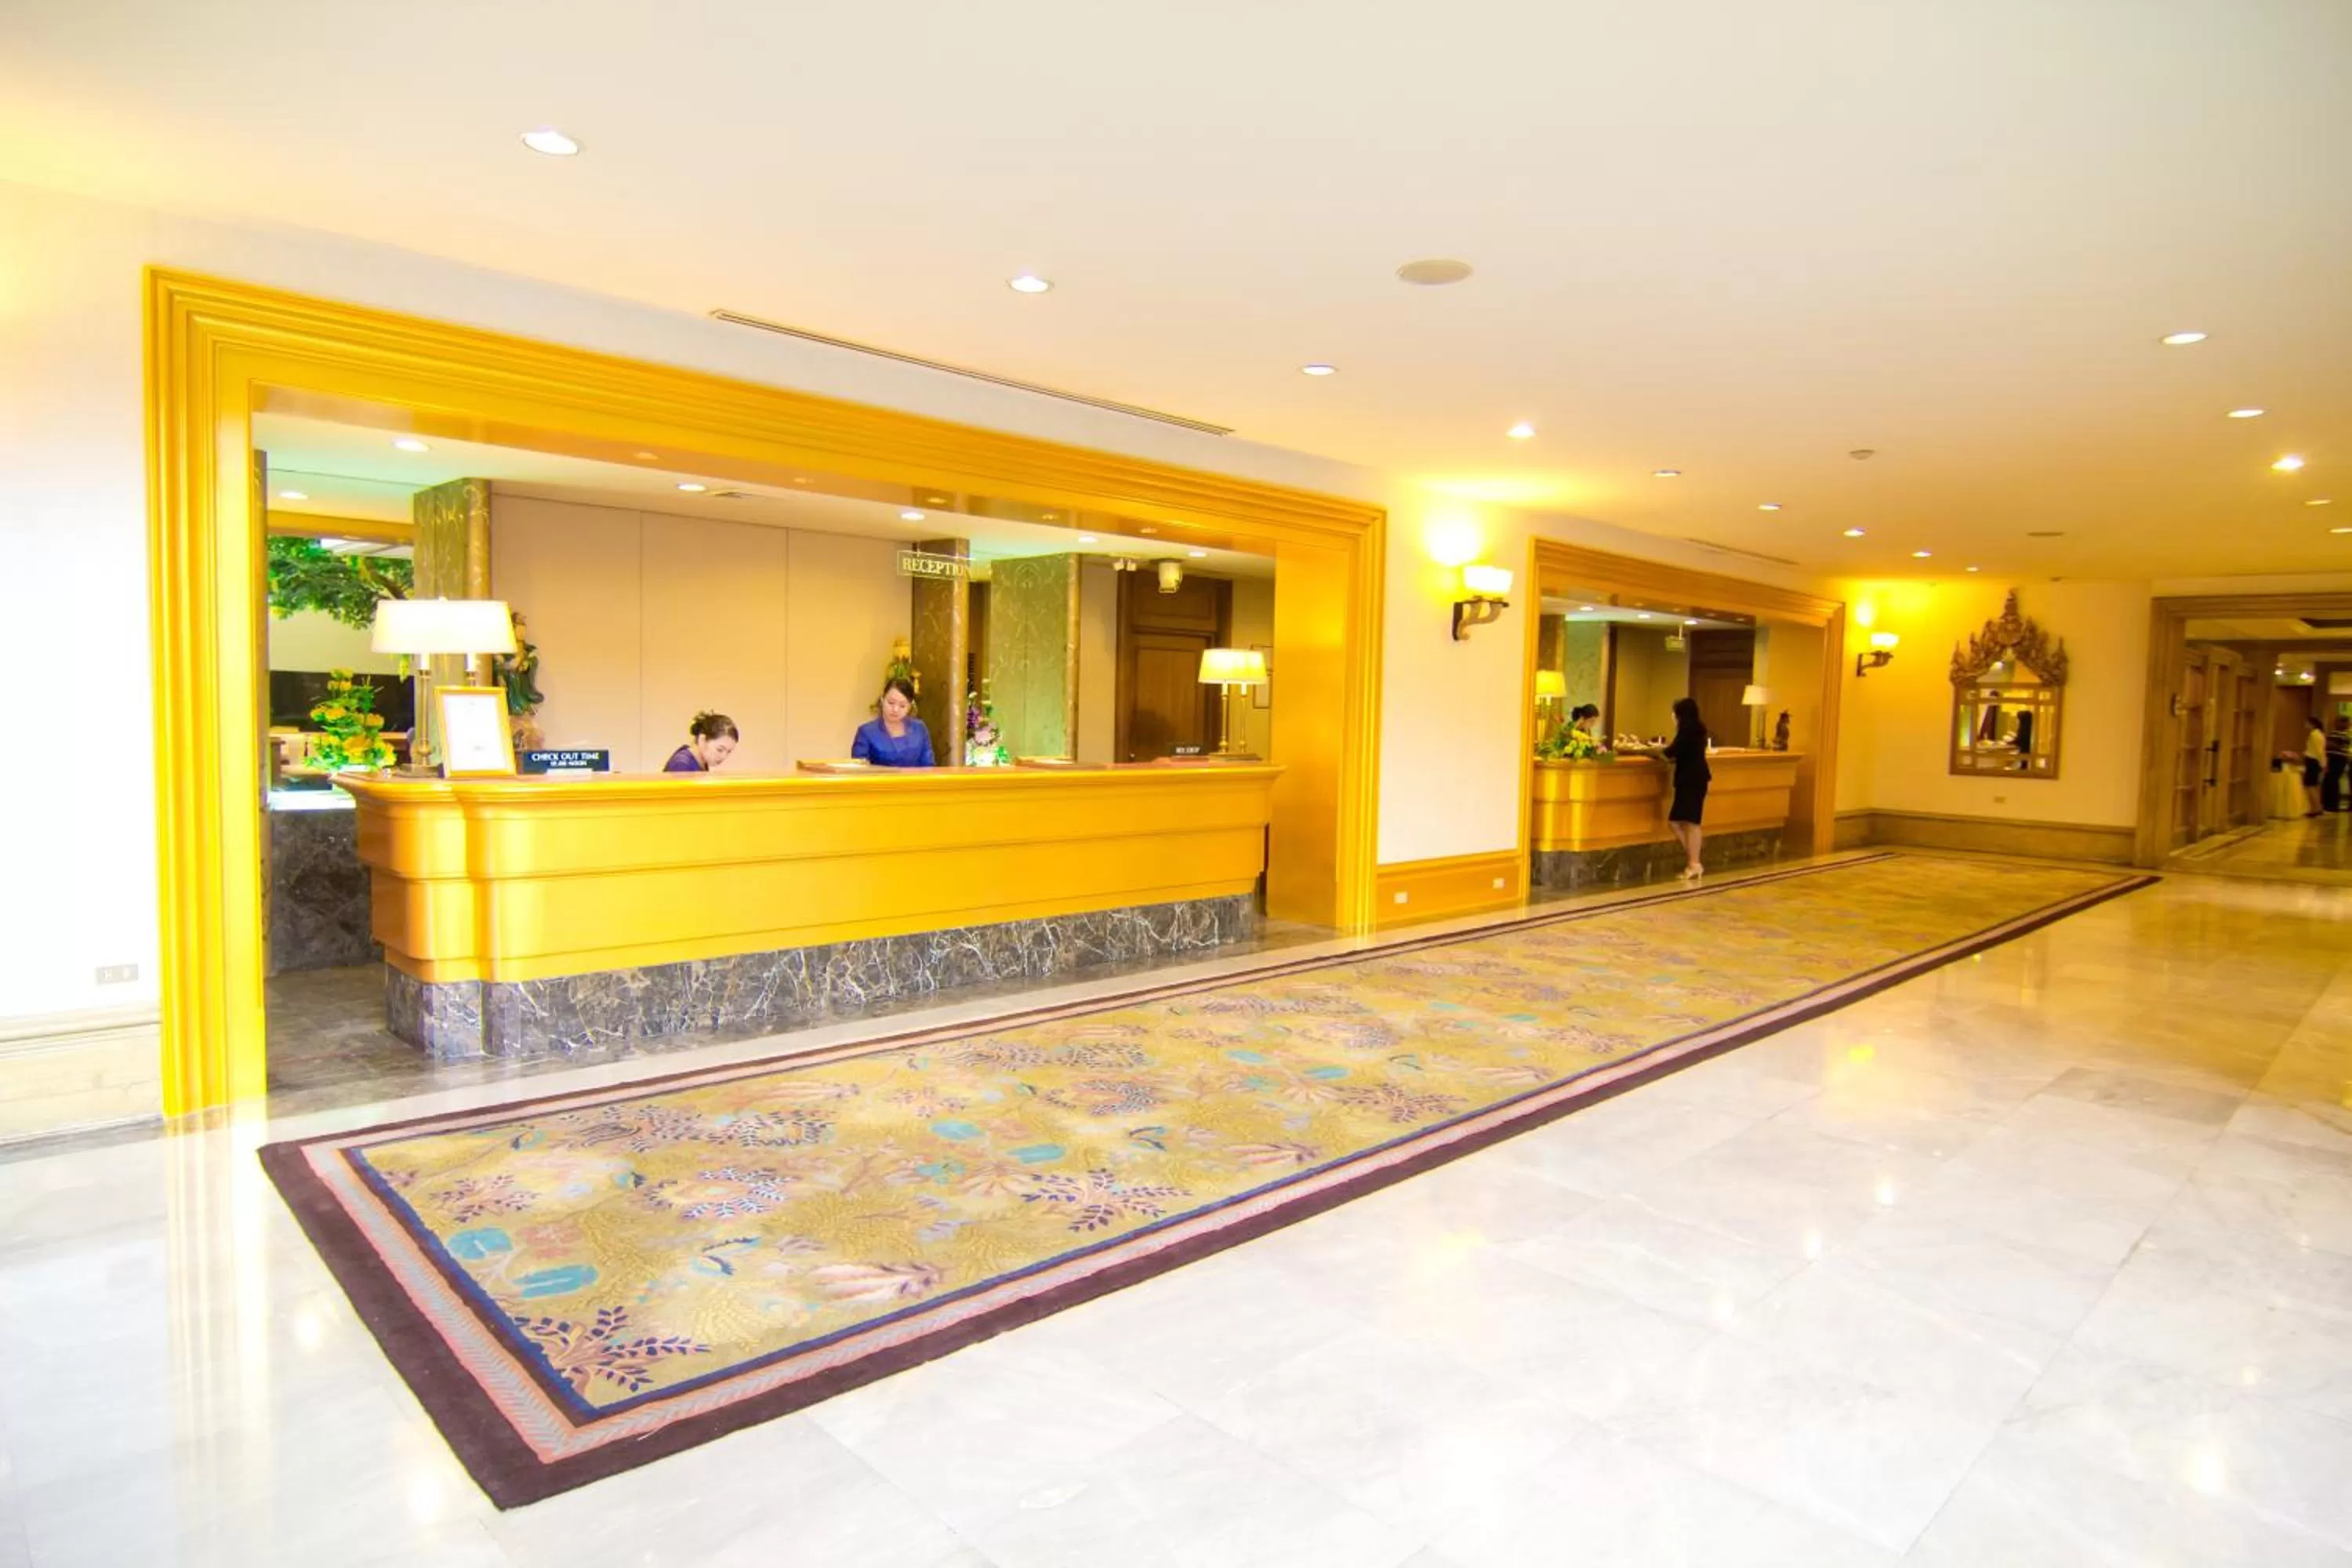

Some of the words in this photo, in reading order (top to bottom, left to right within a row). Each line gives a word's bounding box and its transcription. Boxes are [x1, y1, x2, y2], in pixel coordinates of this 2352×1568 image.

[532, 753, 558, 761] CHECK
[561, 752, 578, 760] OUT
[581, 752, 599, 760] TIME
